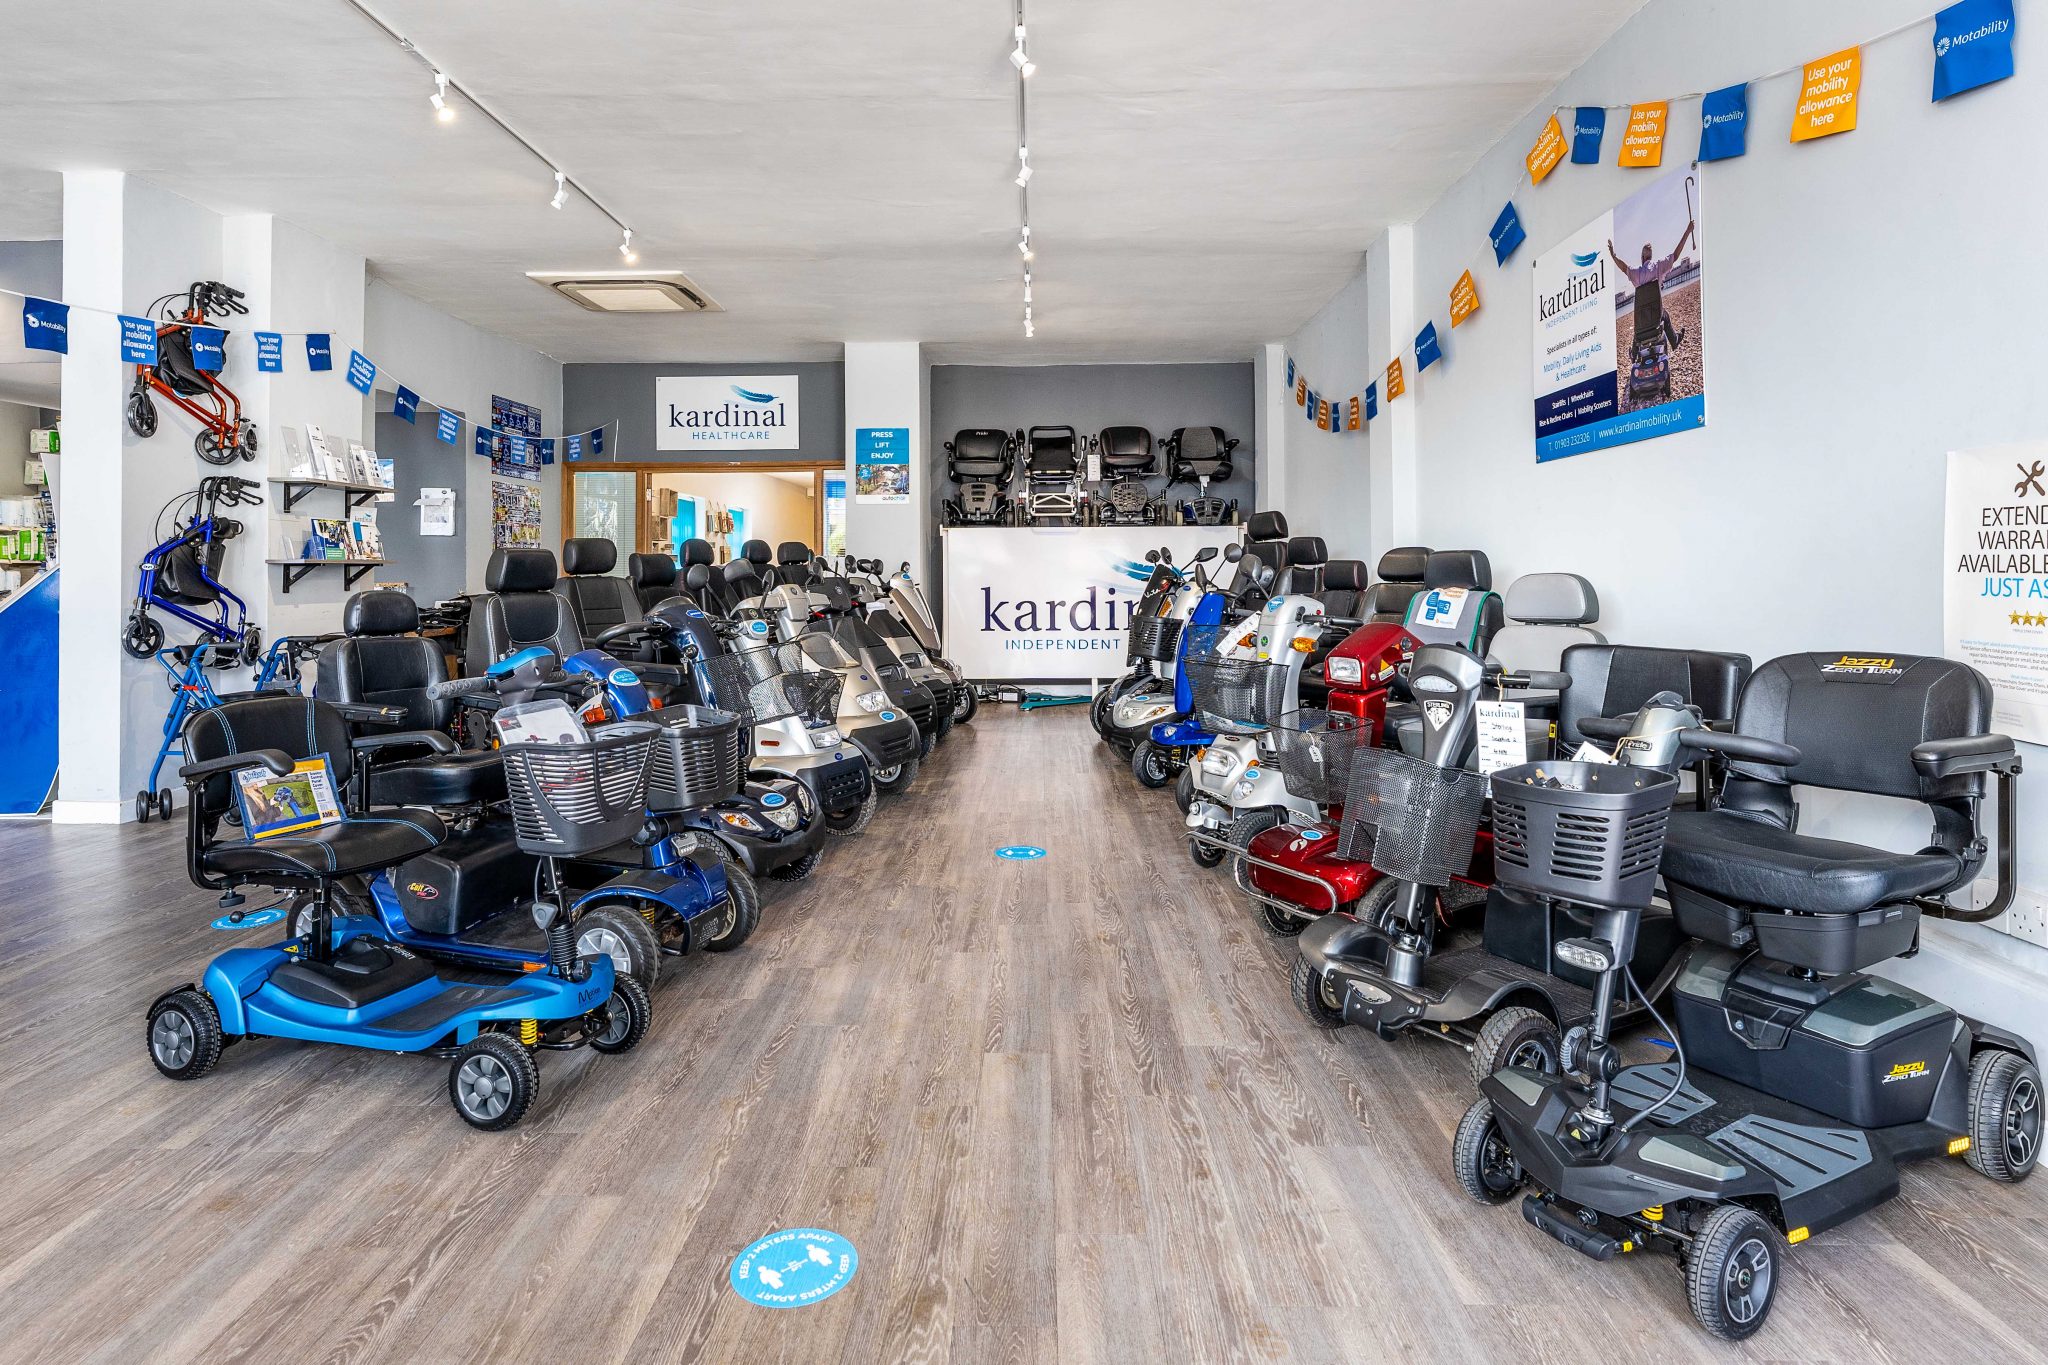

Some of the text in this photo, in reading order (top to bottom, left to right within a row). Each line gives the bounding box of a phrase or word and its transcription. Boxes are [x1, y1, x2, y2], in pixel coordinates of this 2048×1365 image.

[1952, 18, 2010, 48] Motability
[1808, 58, 1852, 82] Use your
[1805, 76, 1849, 98] mobility
[1799, 91, 1853, 116] allowance
[1633, 108, 1661, 121] Use your
[1712, 110, 1745, 124] Motability
[1810, 112, 1834, 128] here
[1580, 126, 1602, 136] Motability
[1631, 121, 1658, 134] mobility
[1531, 130, 1554, 160] mobility
[1625, 135, 1661, 146] allowance
[1531, 135, 1560, 171] allowance
[1632, 147, 1648, 157] here
[1542, 152, 1556, 169] here
[1539, 259, 1606, 322] kardinal
[1545, 298, 1598, 330] INDEPENDENT LIVING
[41, 320, 66, 334] Motability
[124, 320, 152, 332] Use your
[126, 331, 152, 342] mobility
[123, 339, 154, 350] allowance
[131, 349, 146, 359] here
[1561, 363, 1586, 379] Healthcare
[1593, 399, 1612, 411] Scooters
[669, 403, 786, 428] kardinal
[692, 431, 770, 440] HEALTHCARE
[1554, 437, 1570, 450] 01903
[1598, 409, 1682, 439] www.kardinalmobility.uk
[1978, 529, 2048, 550] WARRA
[1981, 577, 2024, 598] JUST
[1005, 639, 1120, 650] INDEPENDENT
[1833, 655, 1895, 668] Jazzy
[1821, 664, 1902, 674] ZERO TURN
[1480, 708, 1520, 718] kardinal
[1889, 1060, 1925, 1074] Jazzy
[739, 1232, 835, 1280] KEEP 2 METERS APART
[833, 1273, 844, 1282] 2
[756, 1291, 797, 1303] APART
